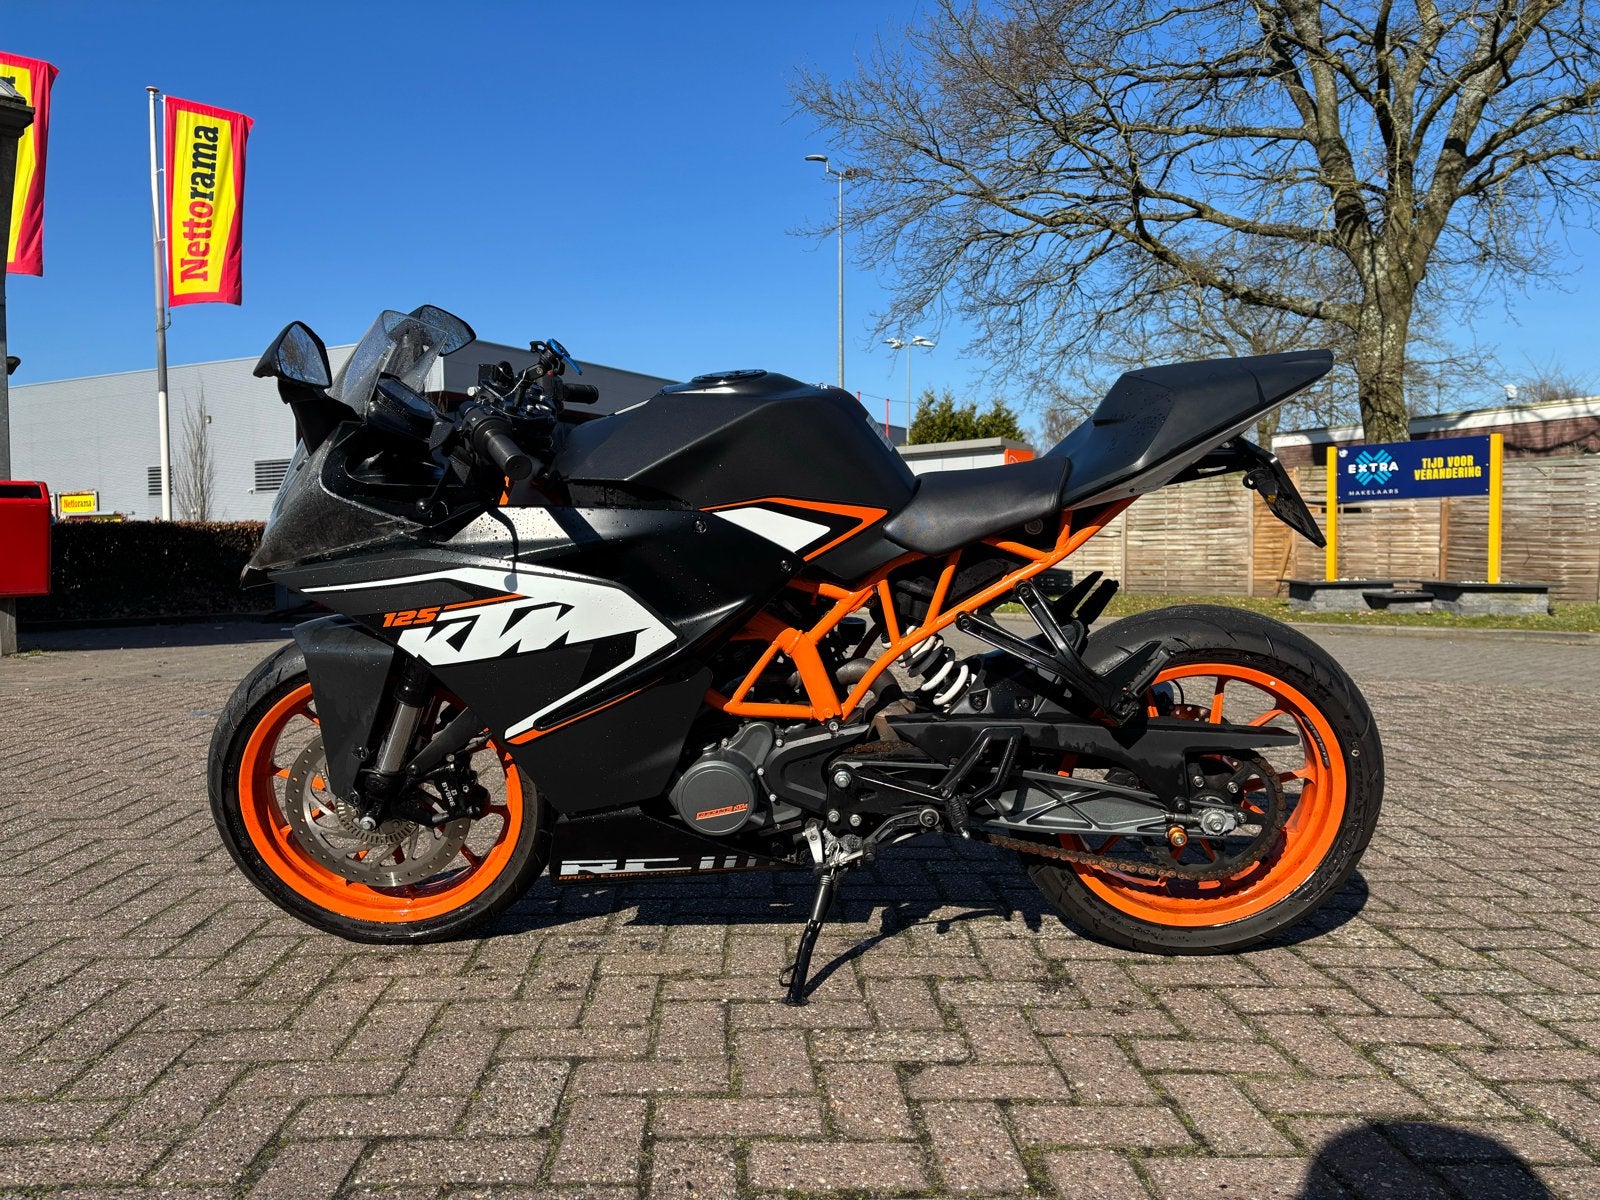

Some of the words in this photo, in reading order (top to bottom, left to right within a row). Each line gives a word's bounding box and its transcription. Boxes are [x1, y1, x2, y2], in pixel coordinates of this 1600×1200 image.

[180, 124, 219, 284] Nettorama
[1347, 461, 1399, 474] EXTRA
[1422, 457, 1443, 469] TIJD
[1447, 455, 1474, 467] VOOR
[1414, 466, 1482, 481] VERANDERING
[1348, 488, 1399, 497] MAKELAARS
[63, 499, 92, 508] Nettorama
[382, 607, 440, 628] 125
[397, 600, 577, 666] KTM
